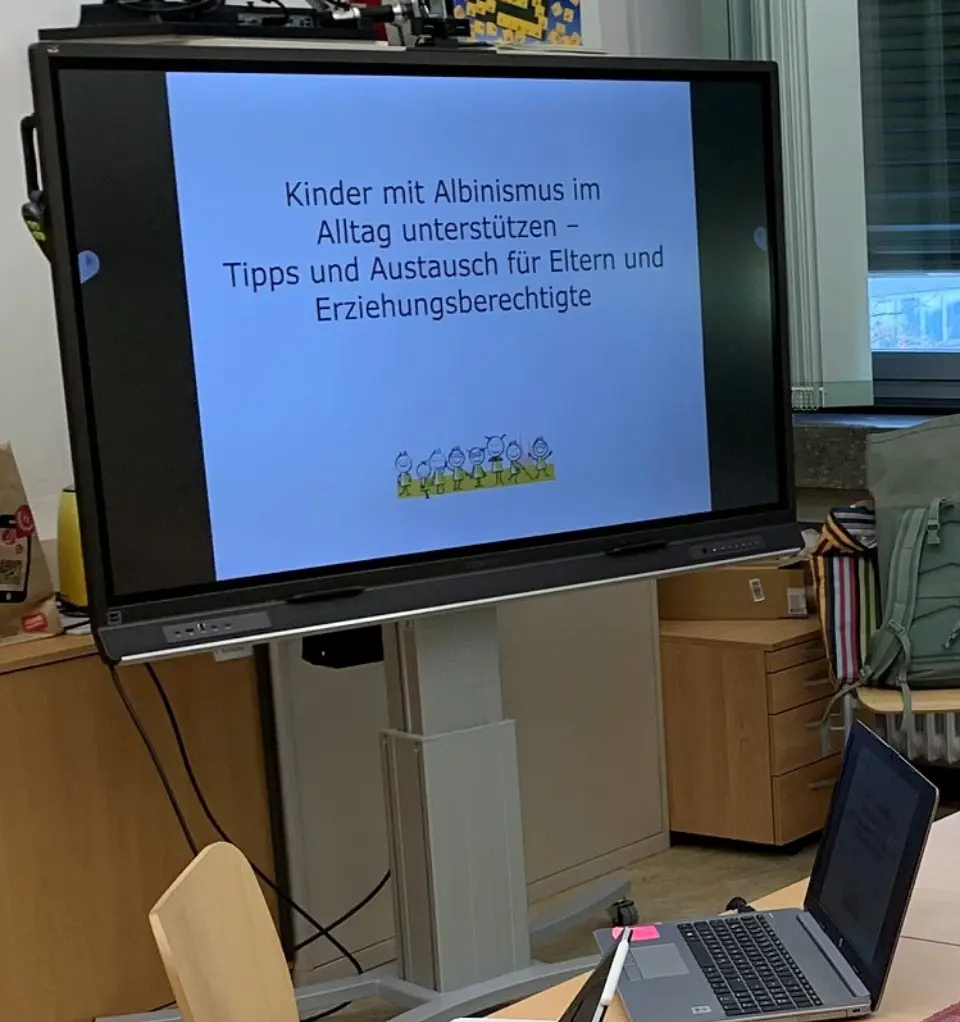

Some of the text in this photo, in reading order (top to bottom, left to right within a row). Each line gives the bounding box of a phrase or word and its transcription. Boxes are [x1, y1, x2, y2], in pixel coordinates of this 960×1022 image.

[285, 177, 601, 207] Kinder mit Albinismus im
[316, 217, 391, 249] Alltag
[402, 214, 557, 243] unterstützen
[222, 244, 665, 293] Tipps und Austausch für Eltern und
[315, 284, 592, 323] Erziehungsberechtigte
